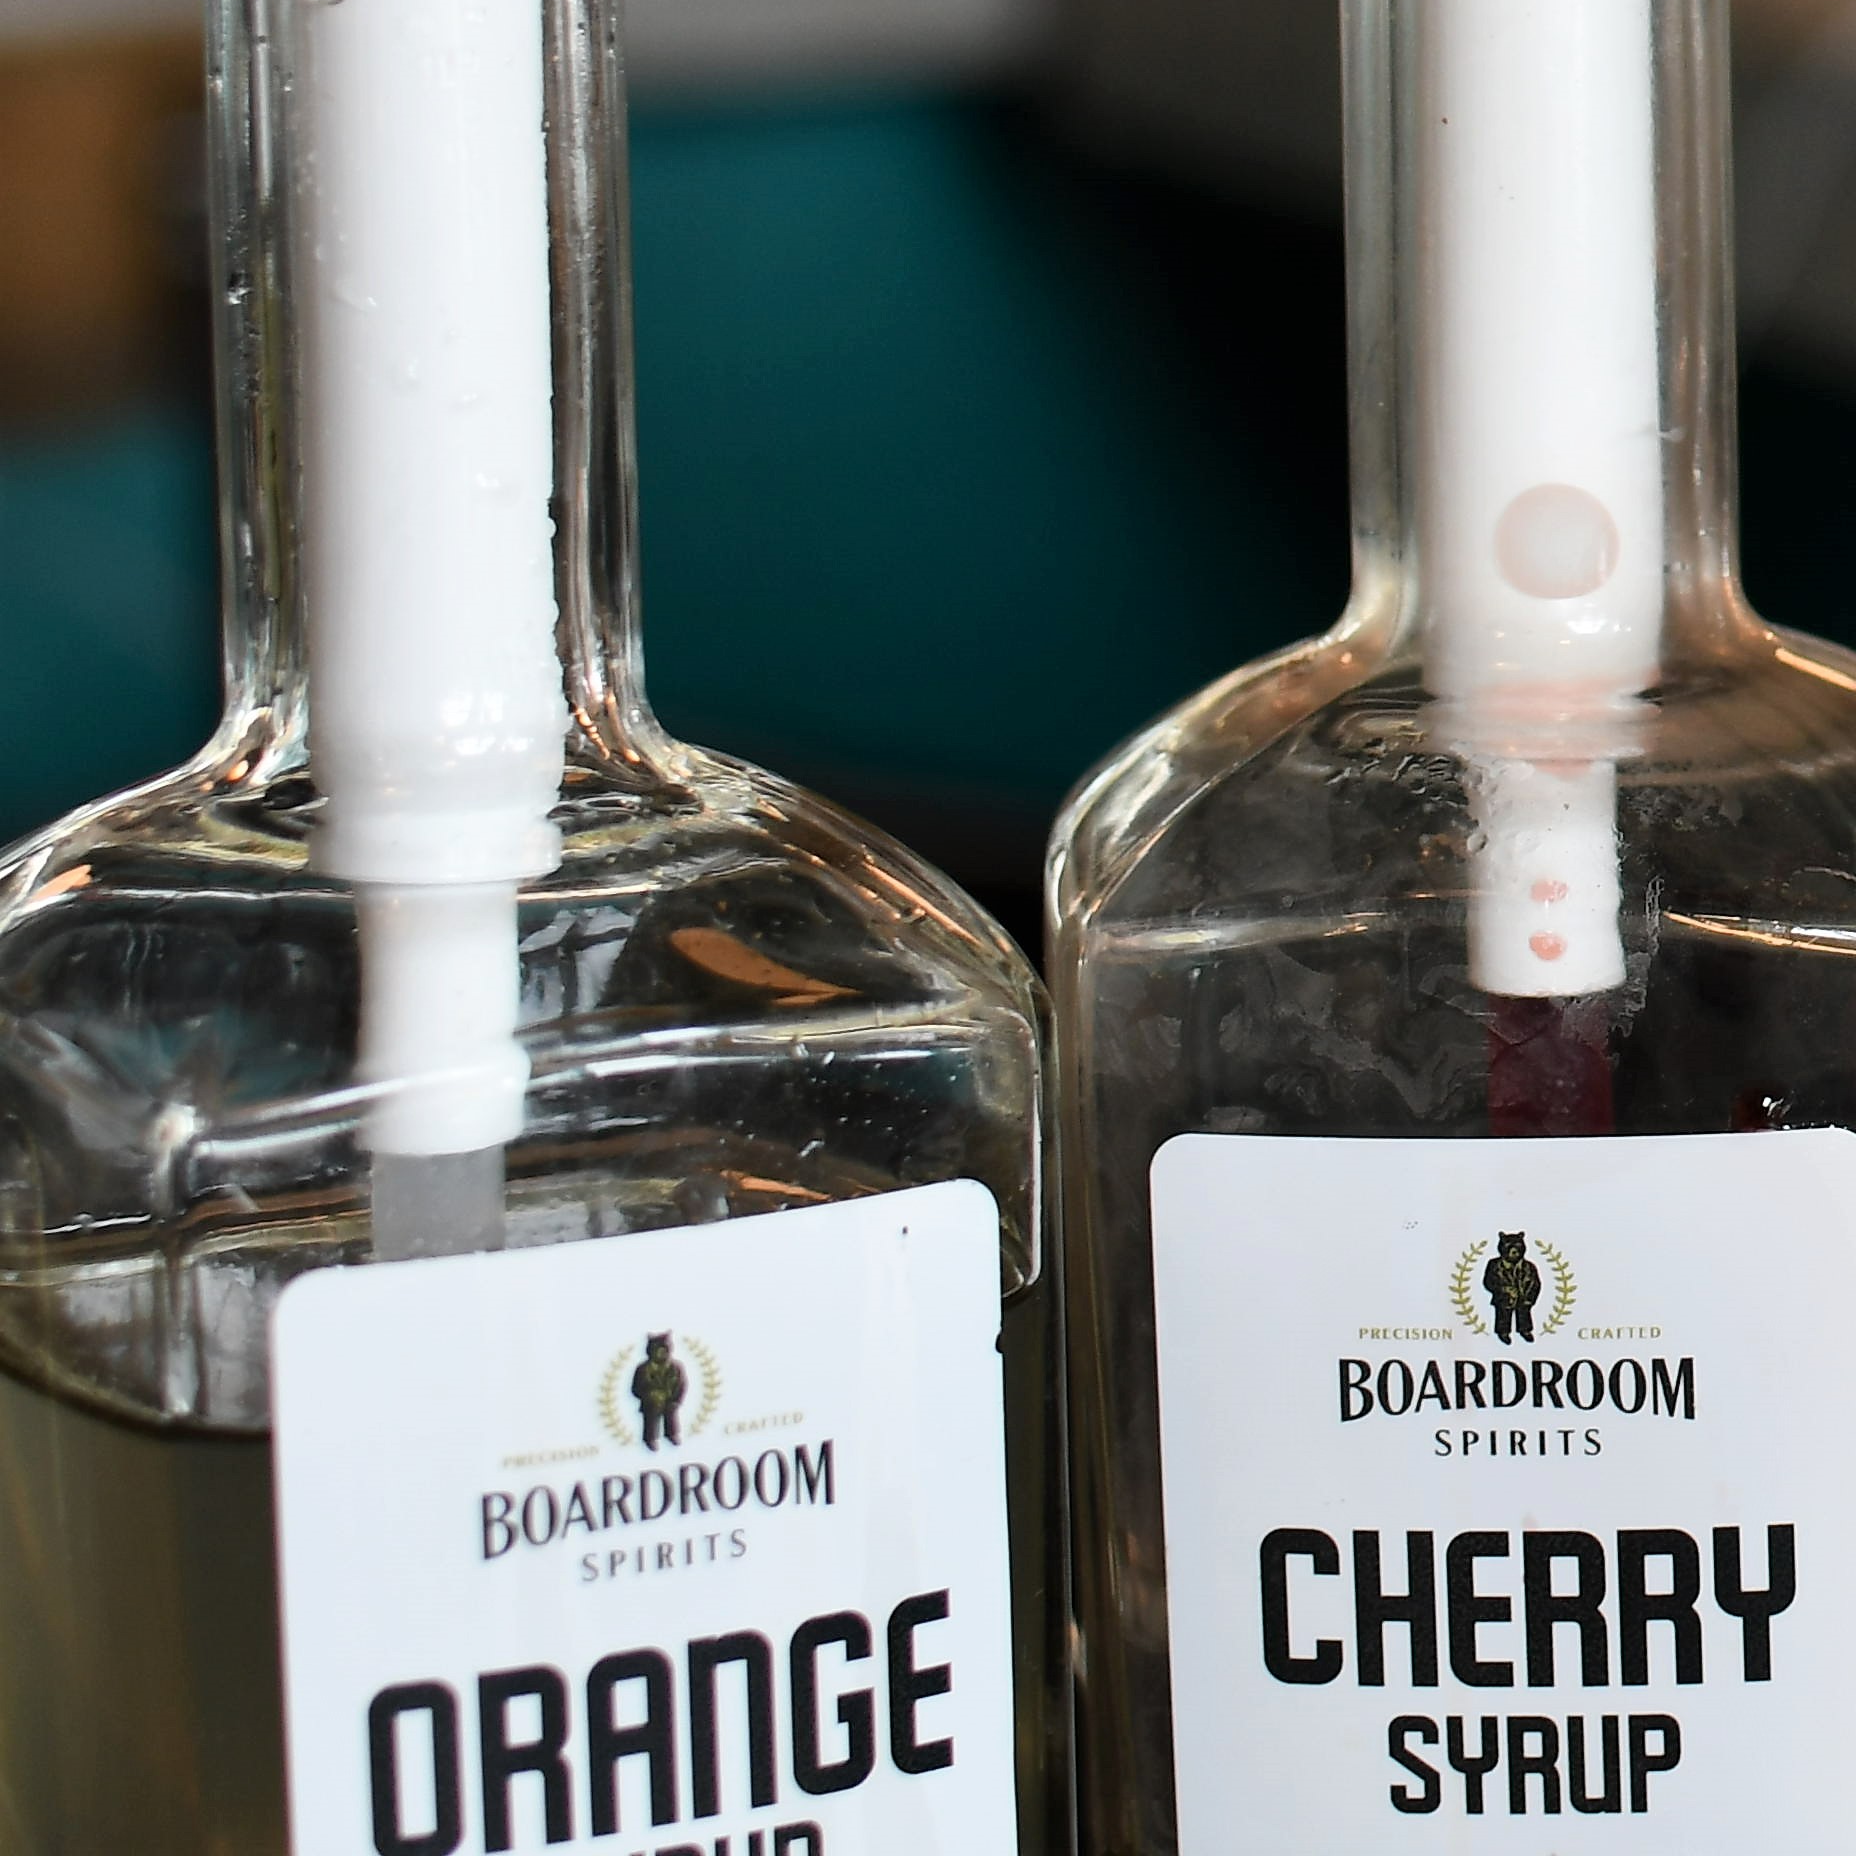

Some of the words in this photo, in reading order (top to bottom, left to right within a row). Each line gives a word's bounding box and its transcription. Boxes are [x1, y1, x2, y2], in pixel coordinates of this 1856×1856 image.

[1358, 1326, 1453, 1342] PRECISION
[1577, 1325, 1662, 1341] CRAFTED
[1338, 1356, 1696, 1423] BOARDROOM
[501, 1445, 600, 1470] PRECISION
[723, 1411, 804, 1437] CRAFTED
[1434, 1428, 1602, 1457] SPIRITS
[481, 1439, 836, 1560] BOARDROOM
[581, 1528, 748, 1583] SPIRITS
[1259, 1523, 1797, 1688] CHERRY
[367, 1588, 955, 1856] ORANGE
[1387, 1713, 1682, 1816] SYRUP
